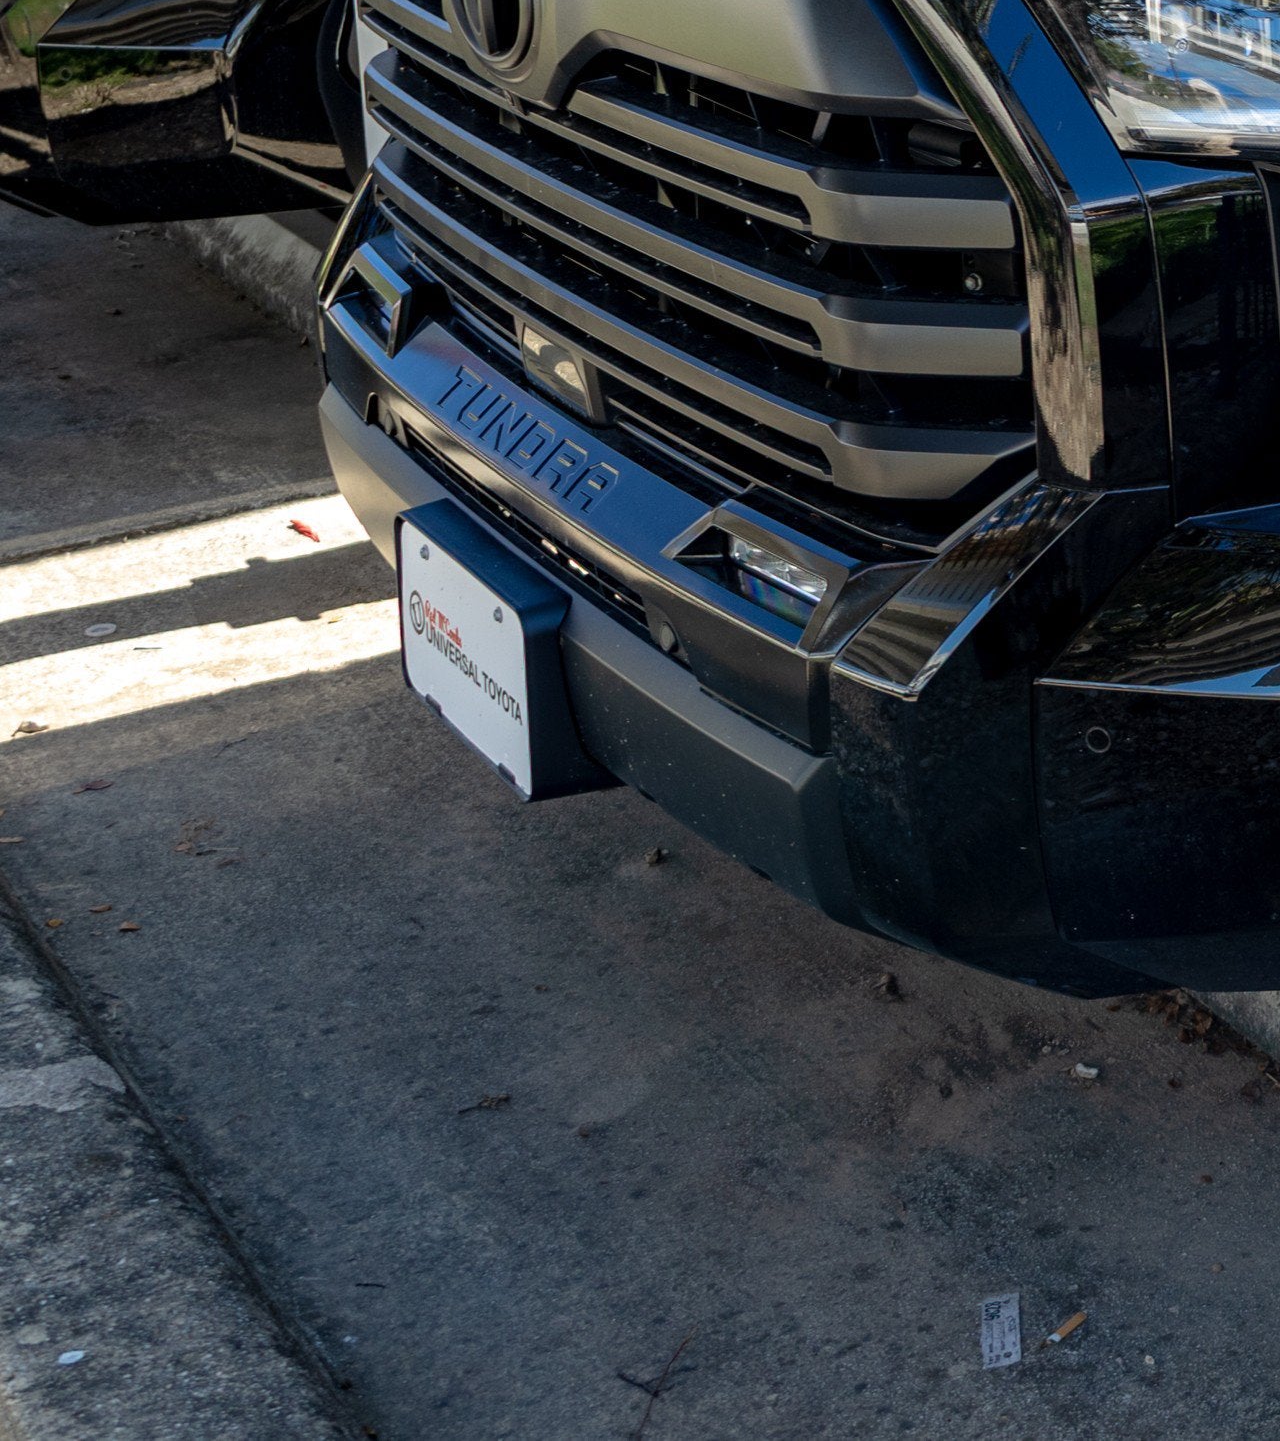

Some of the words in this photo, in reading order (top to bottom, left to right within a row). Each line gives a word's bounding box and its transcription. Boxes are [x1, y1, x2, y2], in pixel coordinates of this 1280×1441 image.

[436, 365, 619, 514] TUNDRA
[426, 622, 481, 688] UNIVERSAL
[482, 671, 523, 726] TOYOTA
